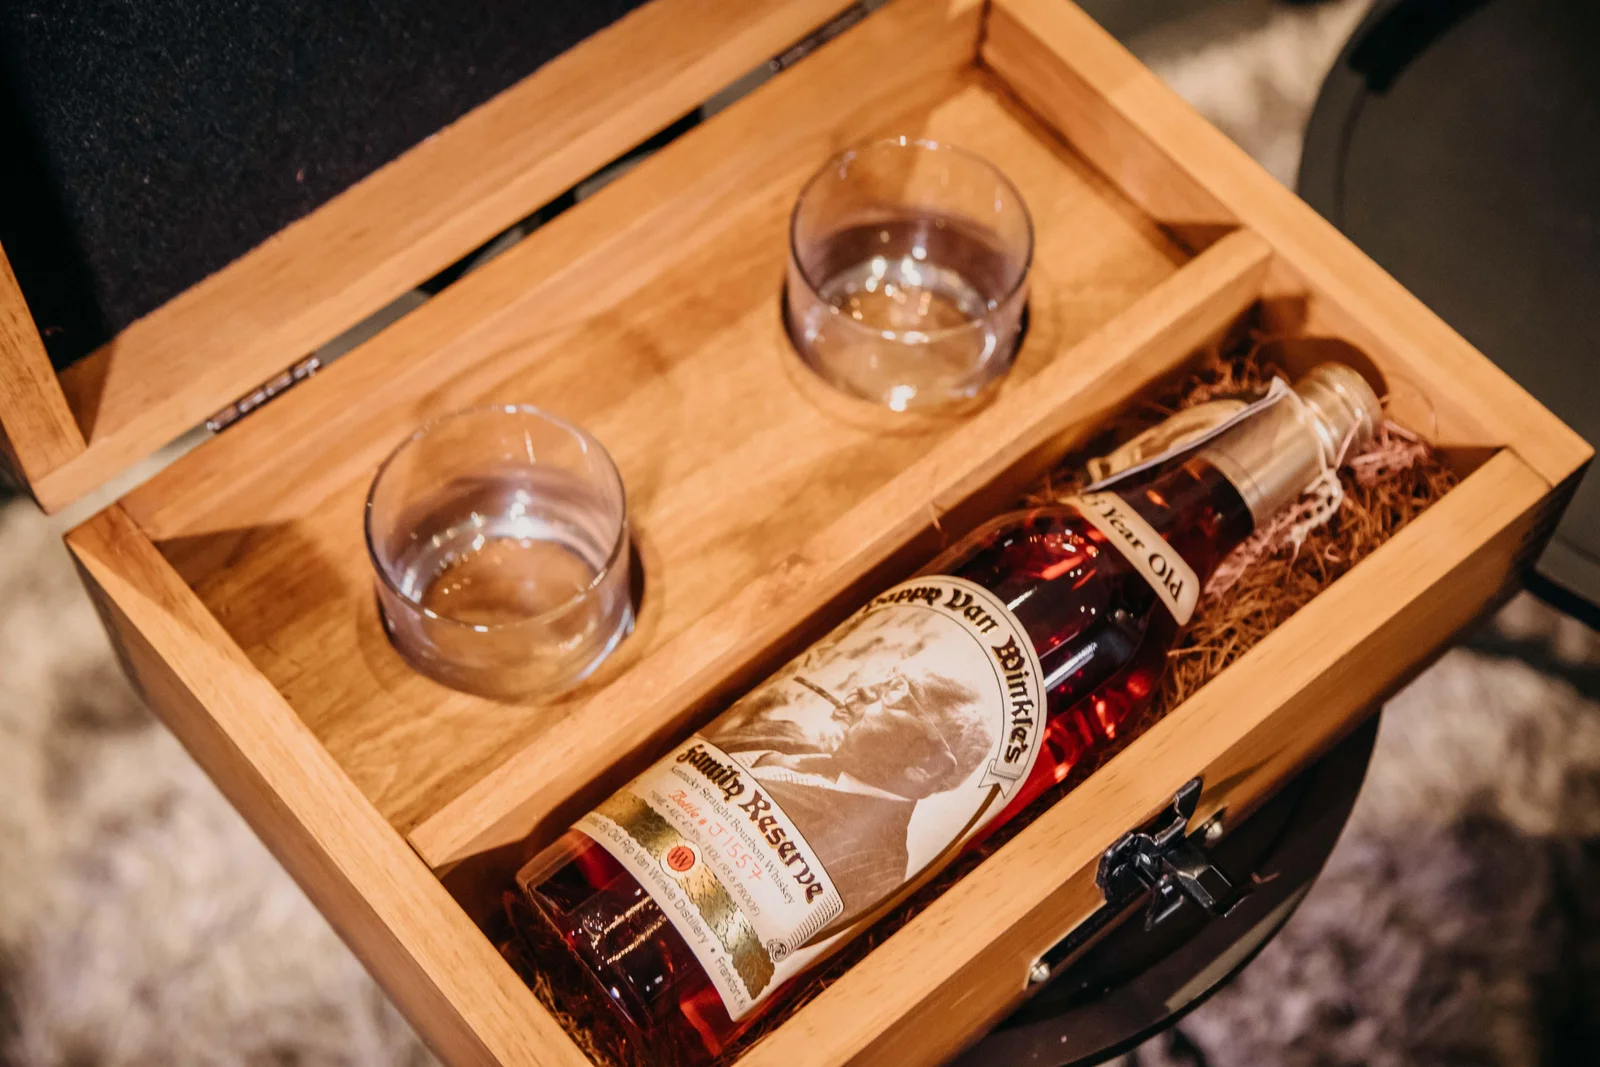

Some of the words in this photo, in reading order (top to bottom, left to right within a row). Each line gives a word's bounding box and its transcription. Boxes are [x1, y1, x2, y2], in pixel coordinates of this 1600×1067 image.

[1101, 507, 1145, 550] Year
[1148, 552, 1184, 603] Old
[943, 588, 999, 635] Van
[992, 634, 1034, 764] Winkle's
[668, 789, 702, 819] Bottle
[676, 743, 745, 802] Family
[739, 789, 824, 904] Reserve
[700, 787, 733, 821] Straight
[731, 818, 766, 862] Bourbon
[765, 860, 795, 904] Whiskey
[634, 850, 650, 870] Van
[648, 866, 681, 898] Winkle
[674, 895, 709, 944] Distillery
